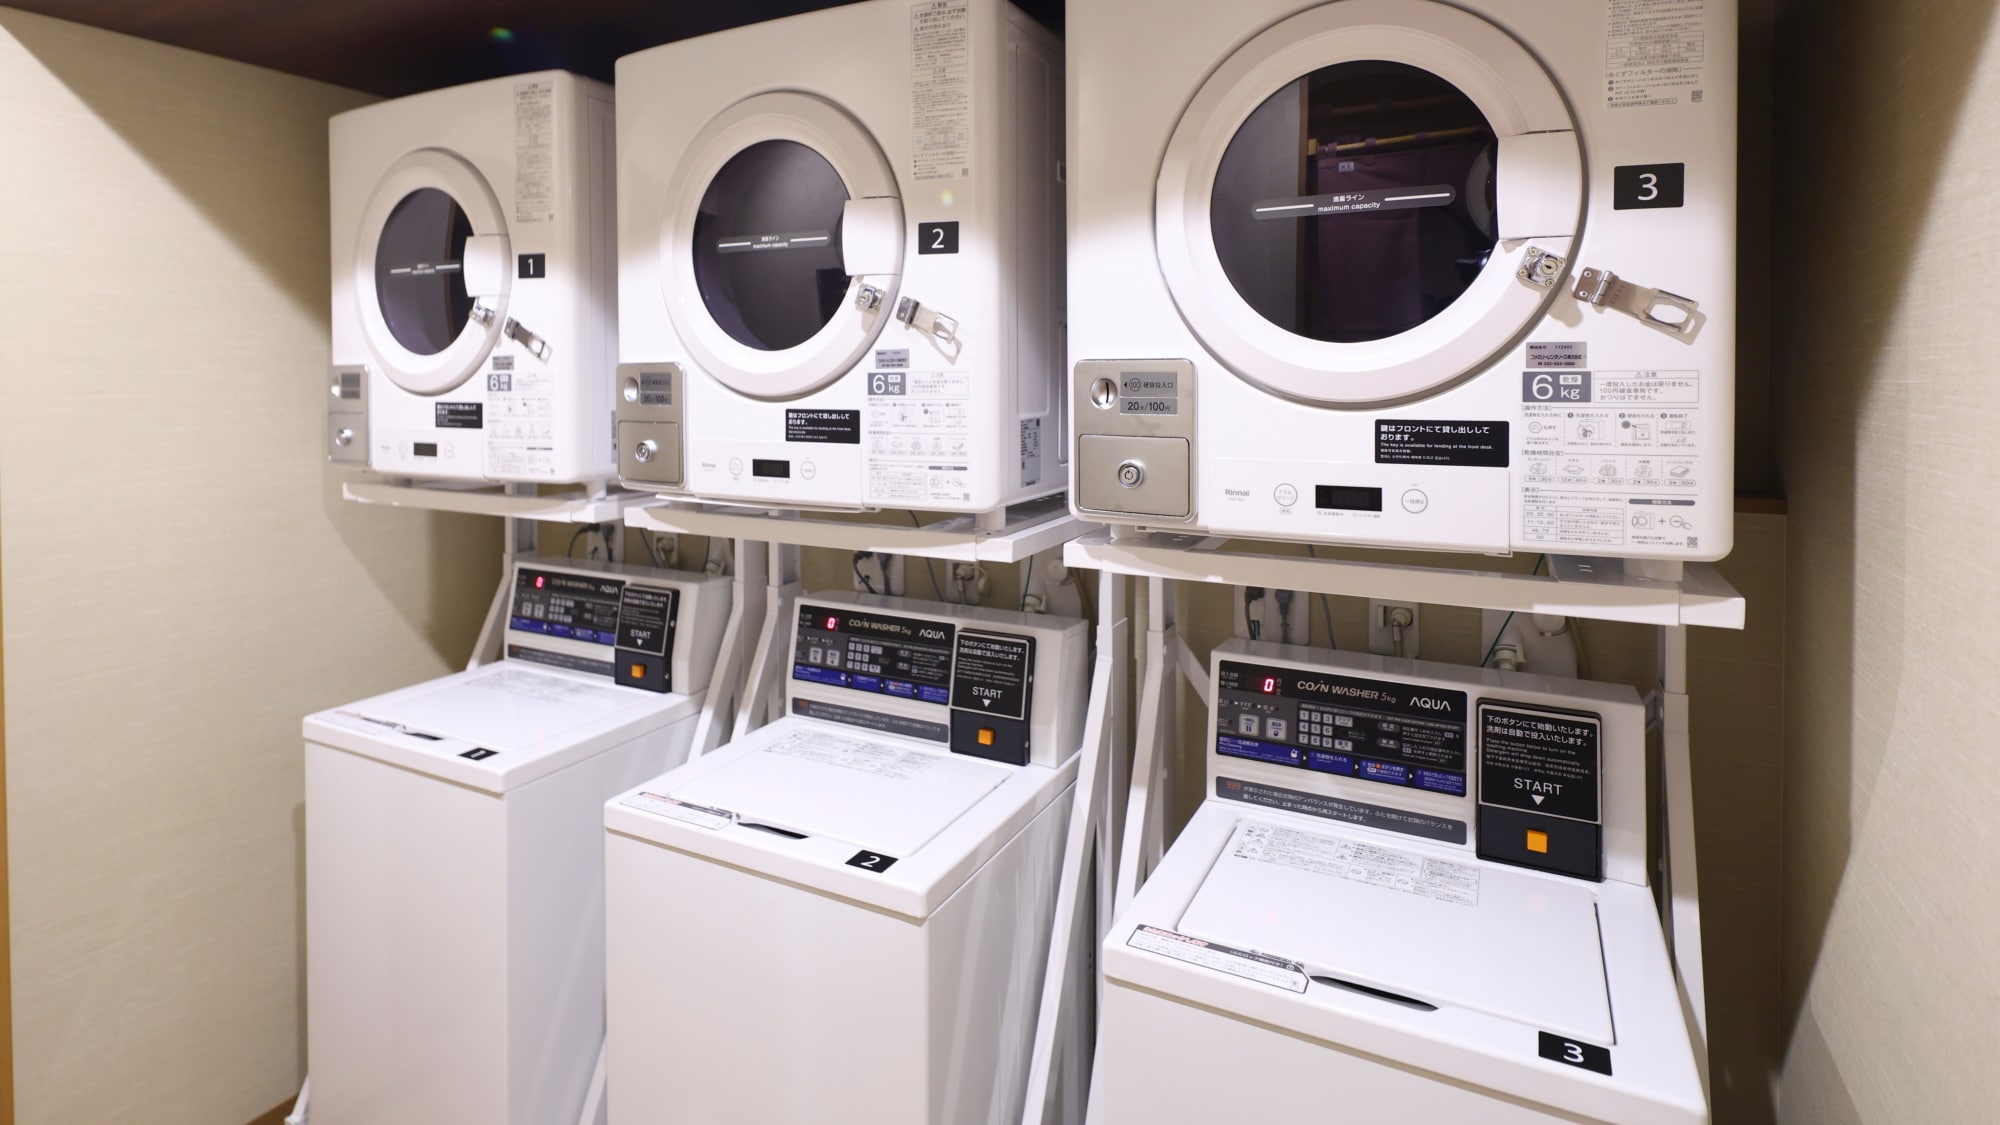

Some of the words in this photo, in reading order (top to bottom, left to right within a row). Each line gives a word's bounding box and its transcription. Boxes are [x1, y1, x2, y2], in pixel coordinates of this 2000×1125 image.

[1638, 173, 1658, 201] 3
[1317, 204, 1350, 213] maximum
[1351, 201, 1381, 211] capacity
[931, 228, 945, 249] 2
[527, 258, 534, 276] 1
[490, 374, 499, 391] 6
[873, 374, 886, 394] 6
[888, 383, 900, 394] kg
[1532, 374, 1554, 400] 6
[1560, 386, 1581, 400] kg
[1224, 488, 1250, 497] Rinnai
[630, 628, 652, 639] START
[919, 628, 945, 640] AQUA
[972, 686, 1003, 699] START
[1264, 678, 1274, 692] 0
[1331, 686, 1379, 699] WASHER
[1381, 693, 1396, 704] 5kg
[1410, 696, 1451, 711] AQUA
[1487, 715, 1594, 737] 下のボタンにて始動いたします。
[1486, 725, 1587, 747] 洗剤は自動で投入いたします。
[1514, 777, 1563, 796] START
[860, 855, 881, 868] 2
[1563, 1043, 1584, 1064] 3
